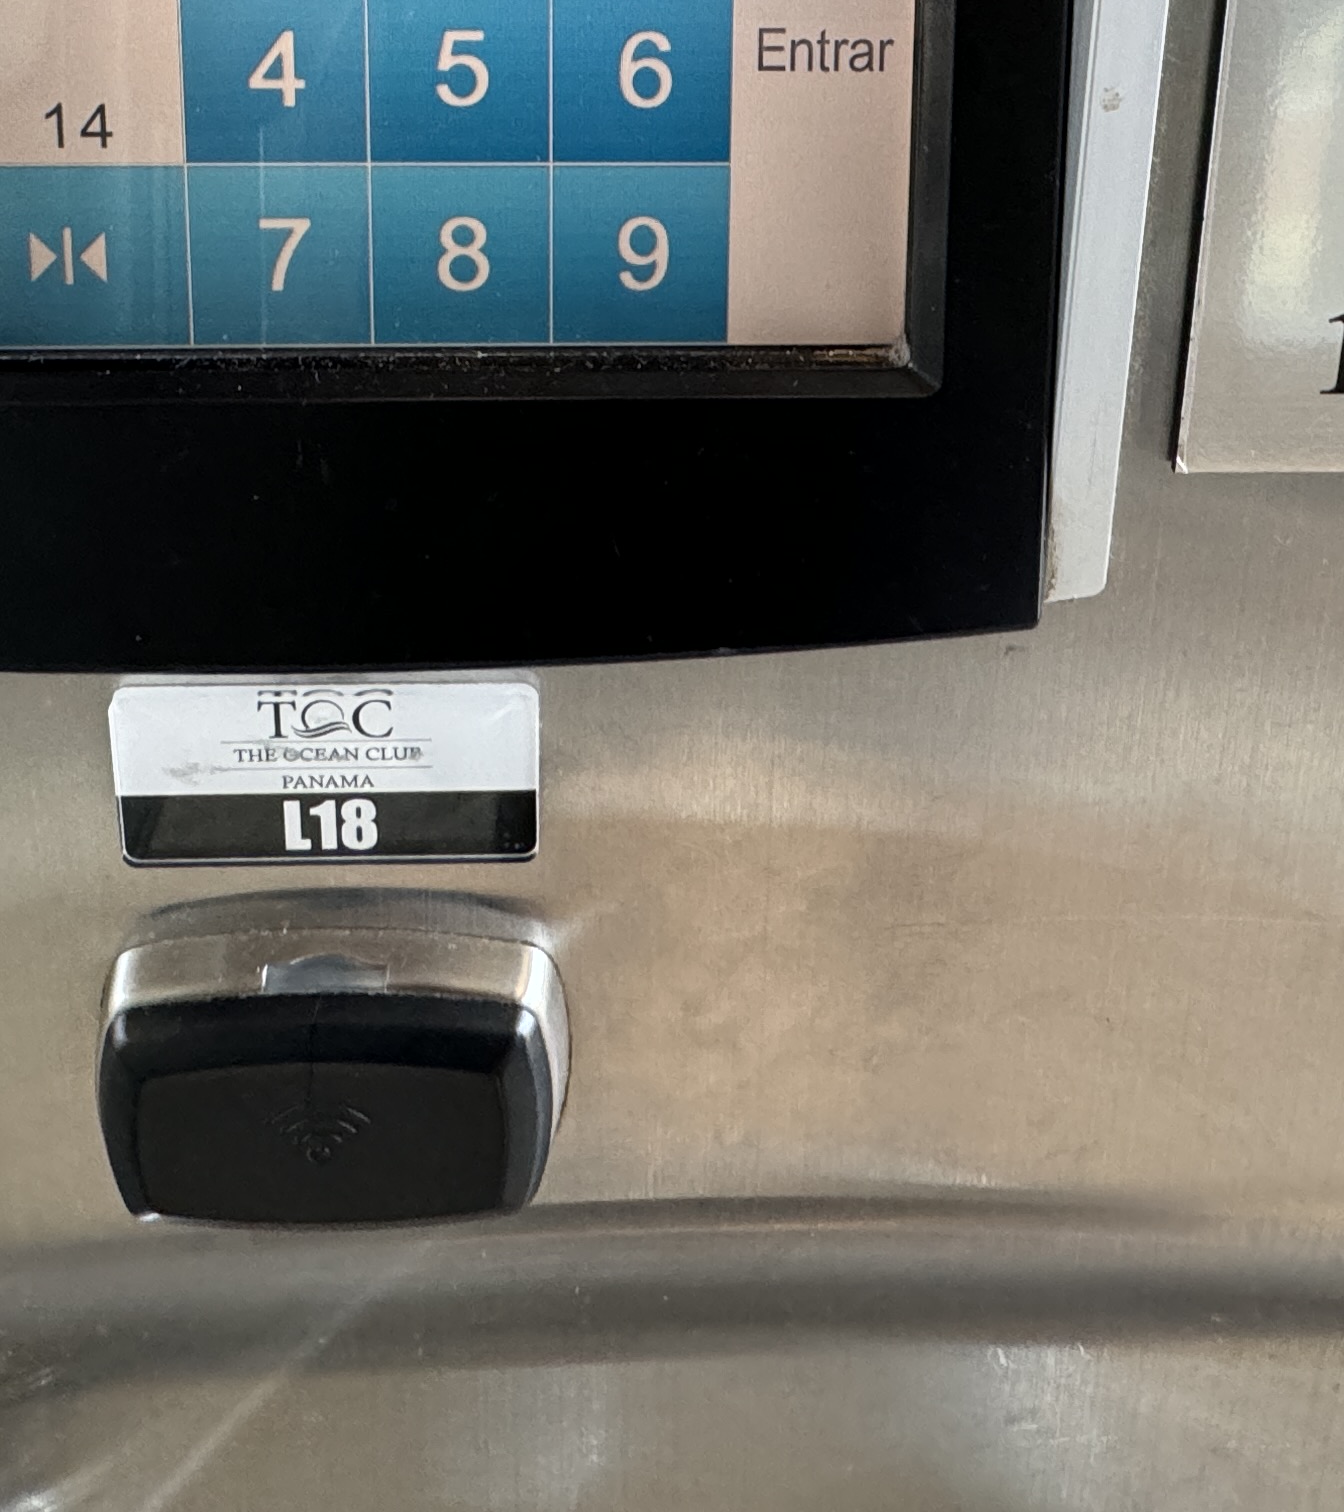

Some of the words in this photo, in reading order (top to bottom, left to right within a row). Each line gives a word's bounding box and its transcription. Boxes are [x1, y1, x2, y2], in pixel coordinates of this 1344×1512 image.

[247, 29, 306, 108] 4
[433, 29, 490, 108] 5
[618, 29, 674, 108] 6
[756, 27, 895, 75] Entrar
[43, 102, 114, 150] 14
[258, 217, 313, 293] 7
[437, 216, 491, 294] 8
[618, 215, 671, 293] 9
[233, 748, 278, 763] THE
[283, 747, 359, 762] OCEAN
[365, 746, 423, 762] CLUB
[282, 774, 375, 789] PANAMA
[282, 798, 378, 851] L18
